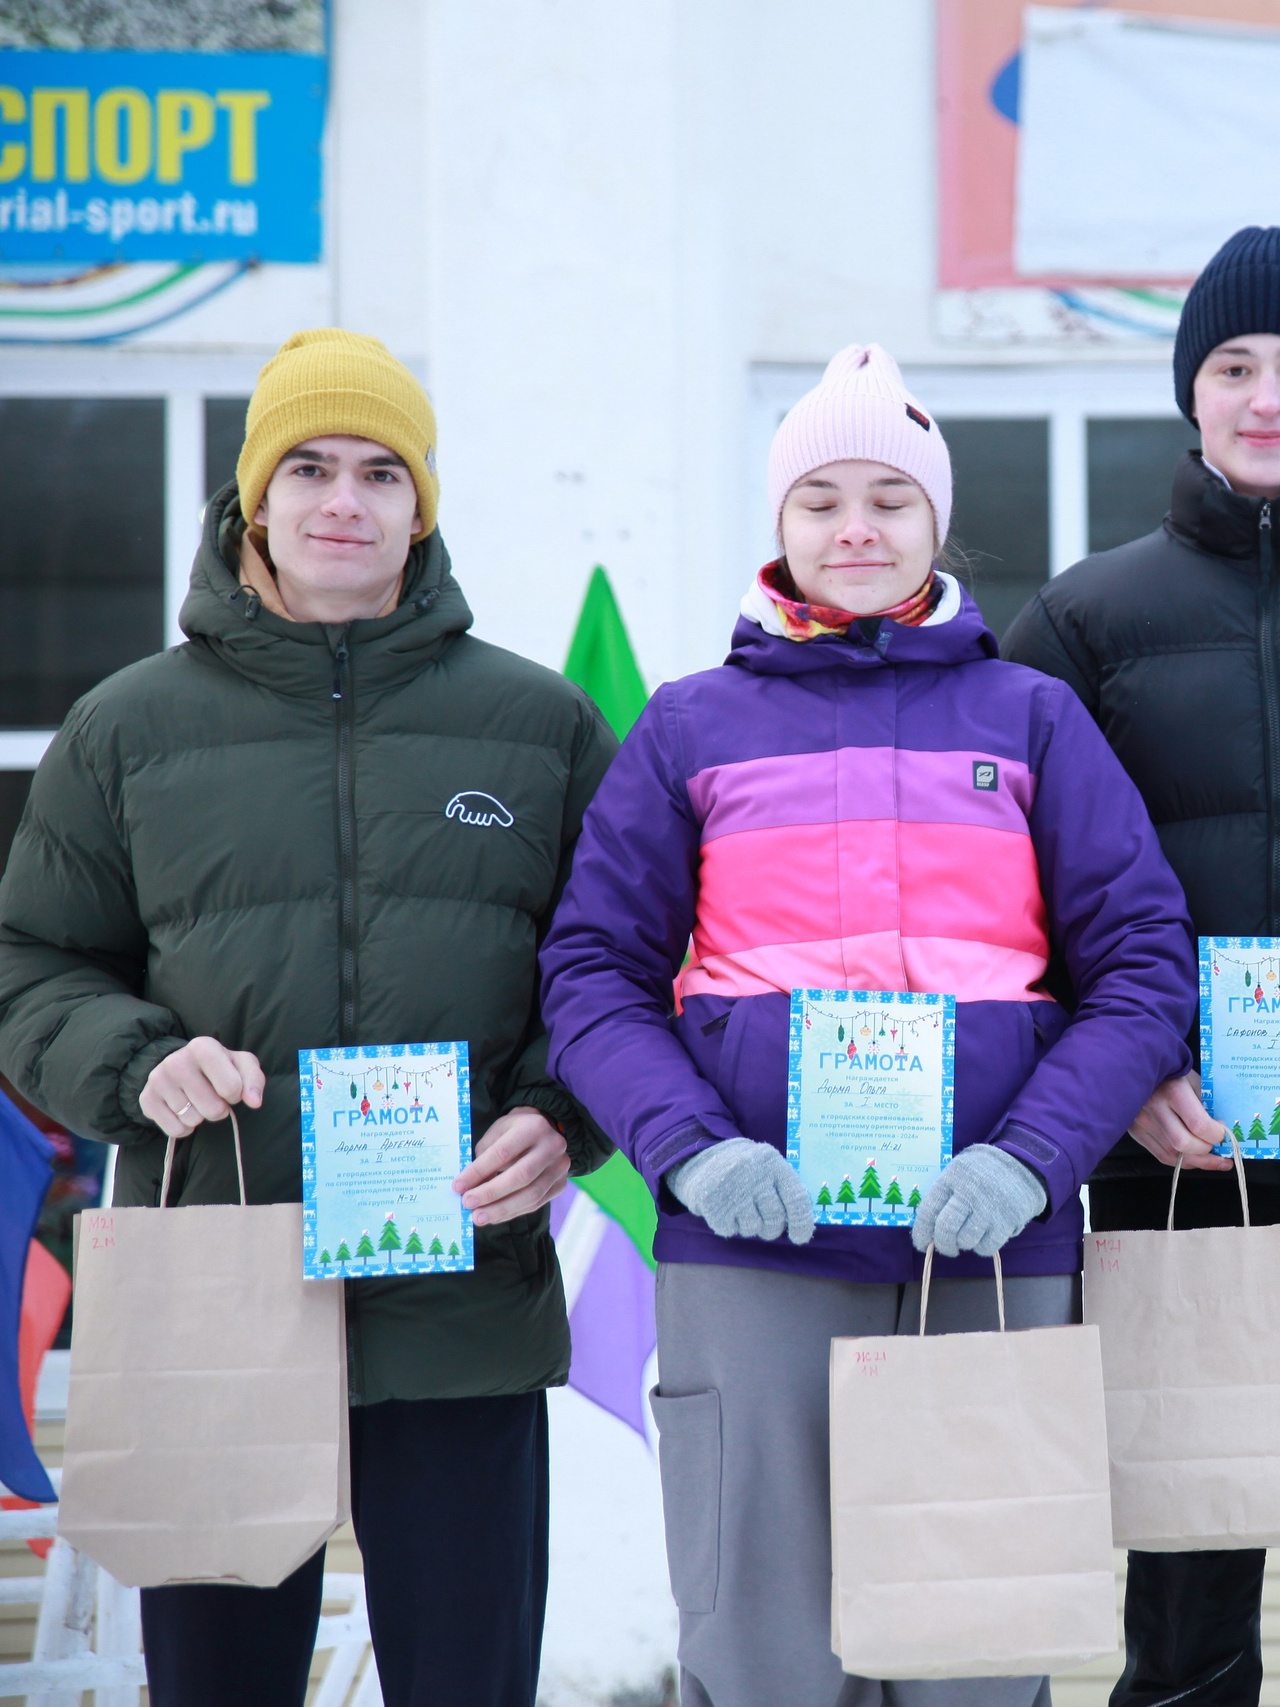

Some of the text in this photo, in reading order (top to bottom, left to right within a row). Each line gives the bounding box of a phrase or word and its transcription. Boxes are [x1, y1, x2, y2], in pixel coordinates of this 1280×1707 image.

[820, 1052, 923, 1072] ГРАМОТА
[333, 1106, 439, 1127] ГРАМОТА
[360, 1130, 414, 1138] Награждается
[384, 1168, 442, 1176] соревнованиях
